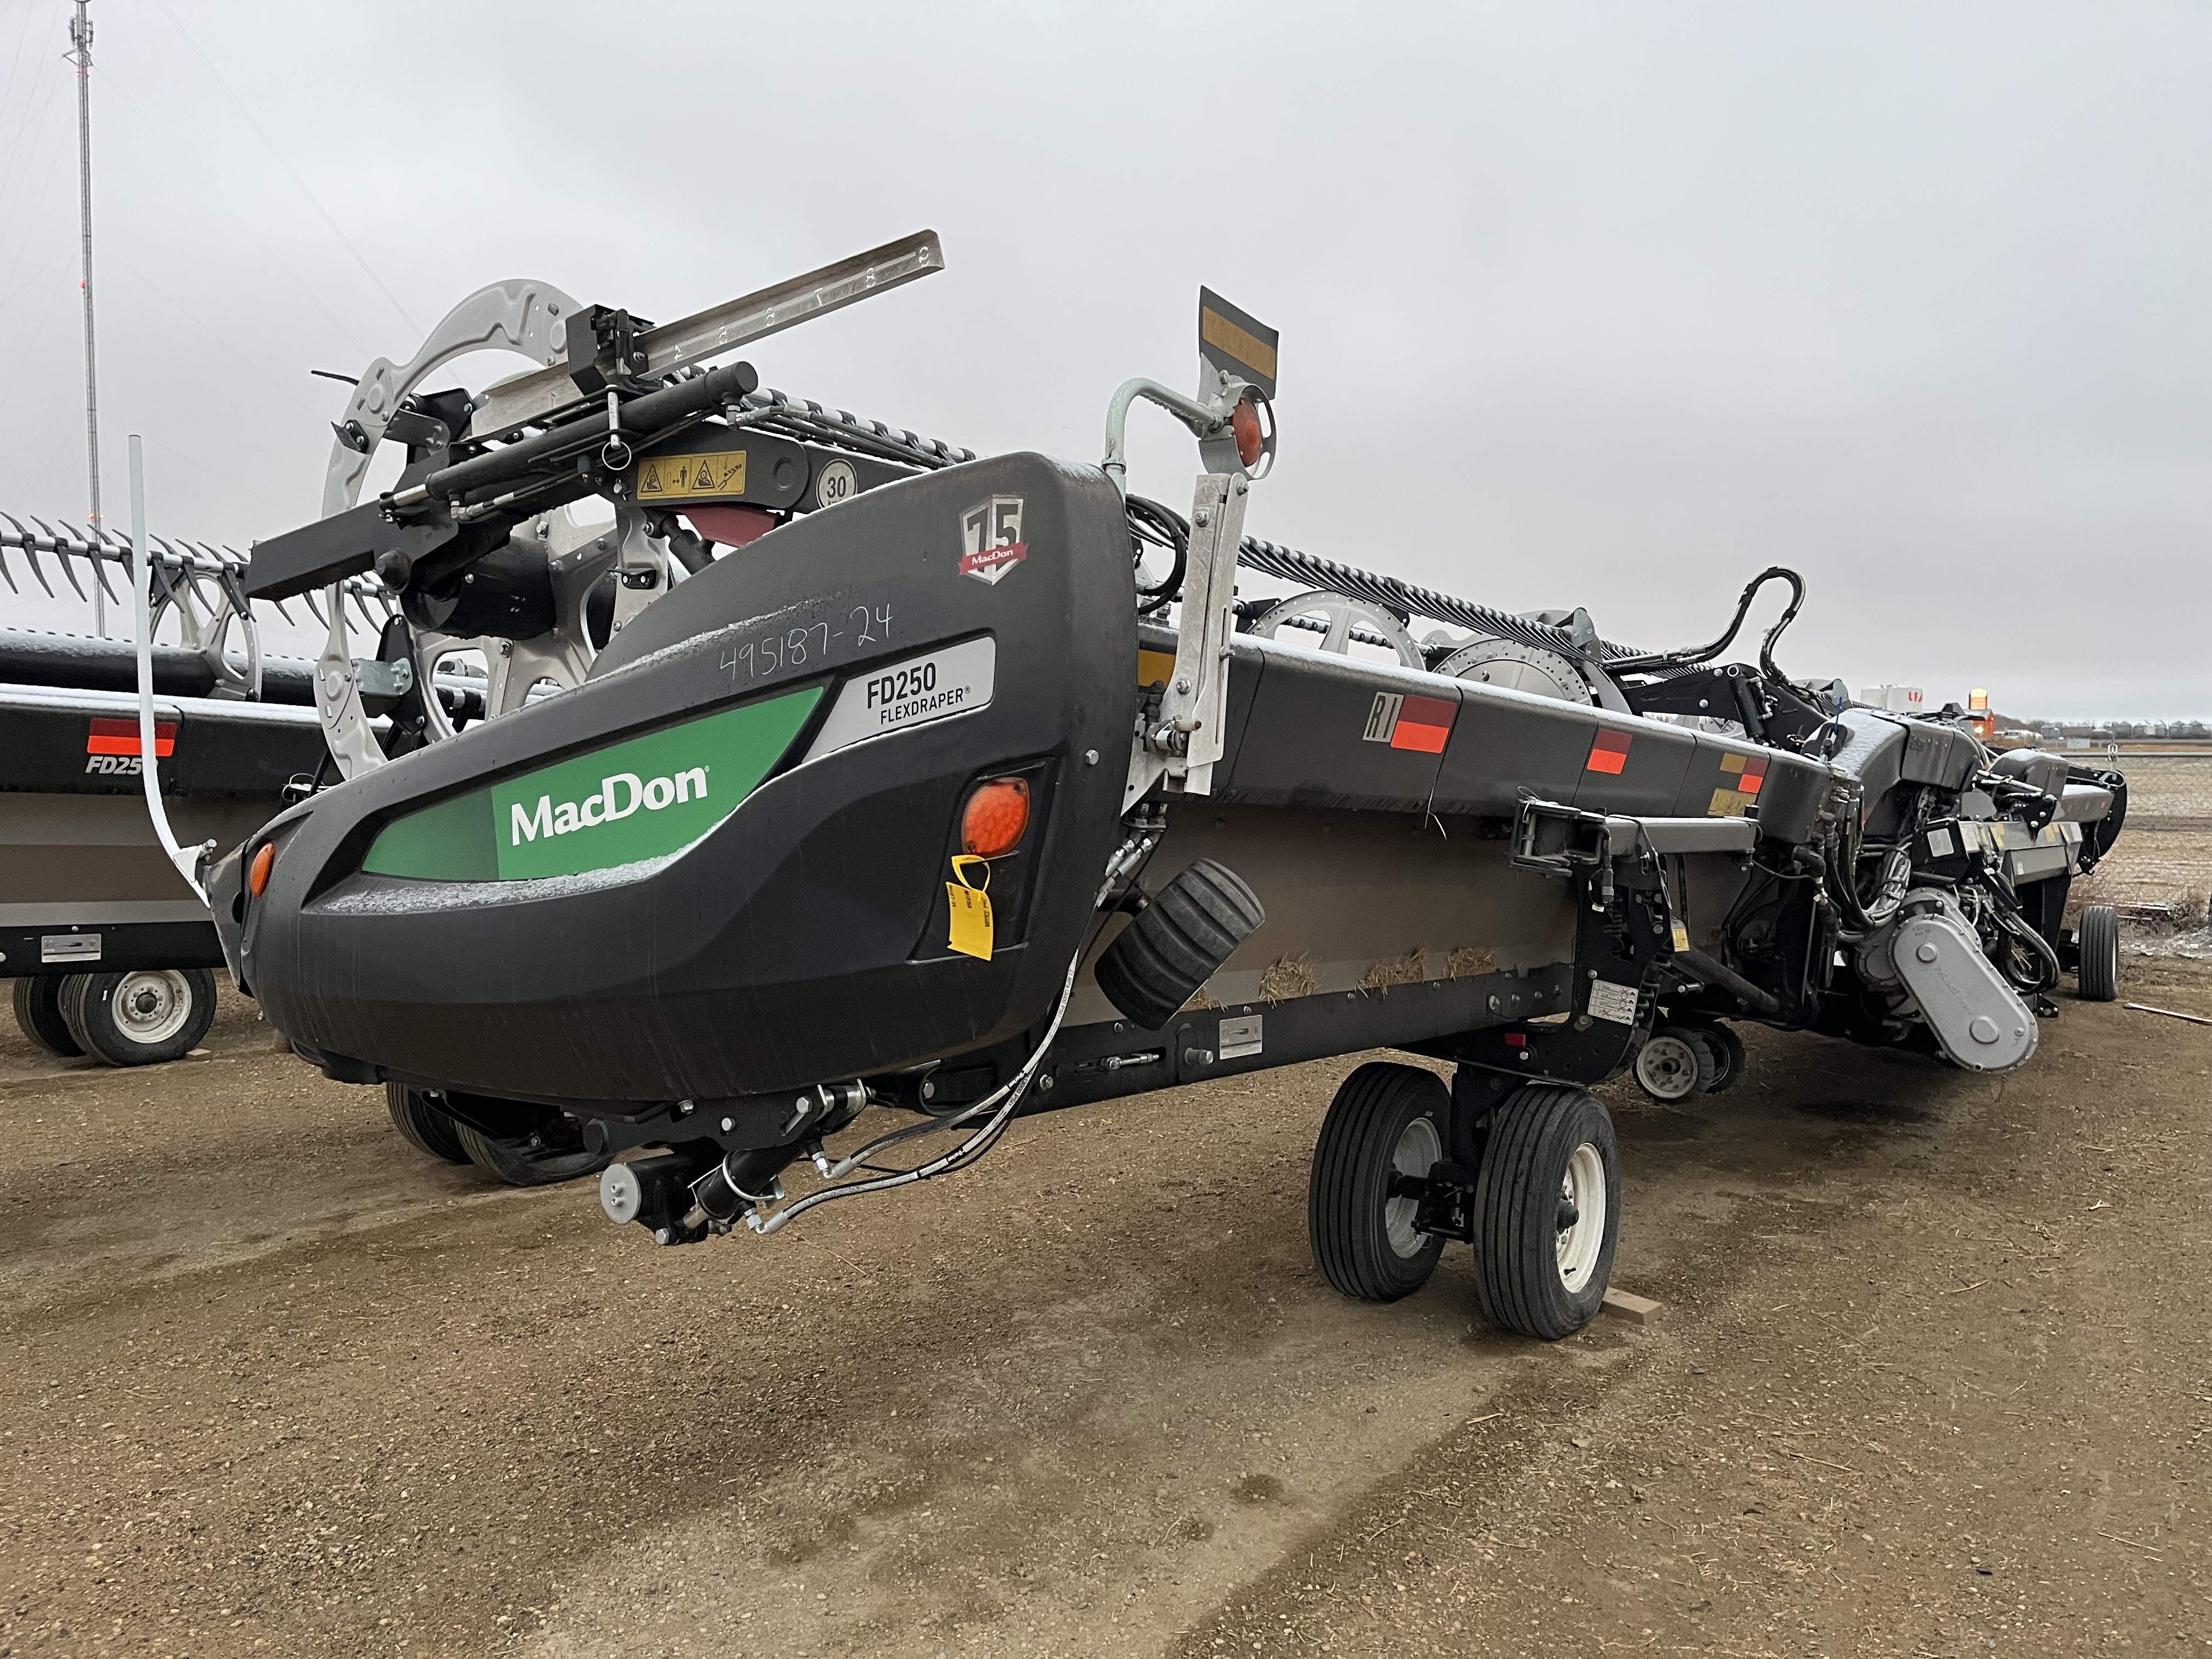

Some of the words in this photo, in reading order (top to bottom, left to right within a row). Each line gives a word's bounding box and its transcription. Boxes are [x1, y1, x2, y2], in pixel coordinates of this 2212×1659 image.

[827, 476, 846, 498] 30
[967, 504, 1019, 573] 75
[972, 549, 1014, 566] MacDon
[720, 603, 893, 681] 495187-24
[867, 662, 936, 709] FD250
[85, 755, 159, 775] FD25
[511, 767, 708, 846] MacDon
